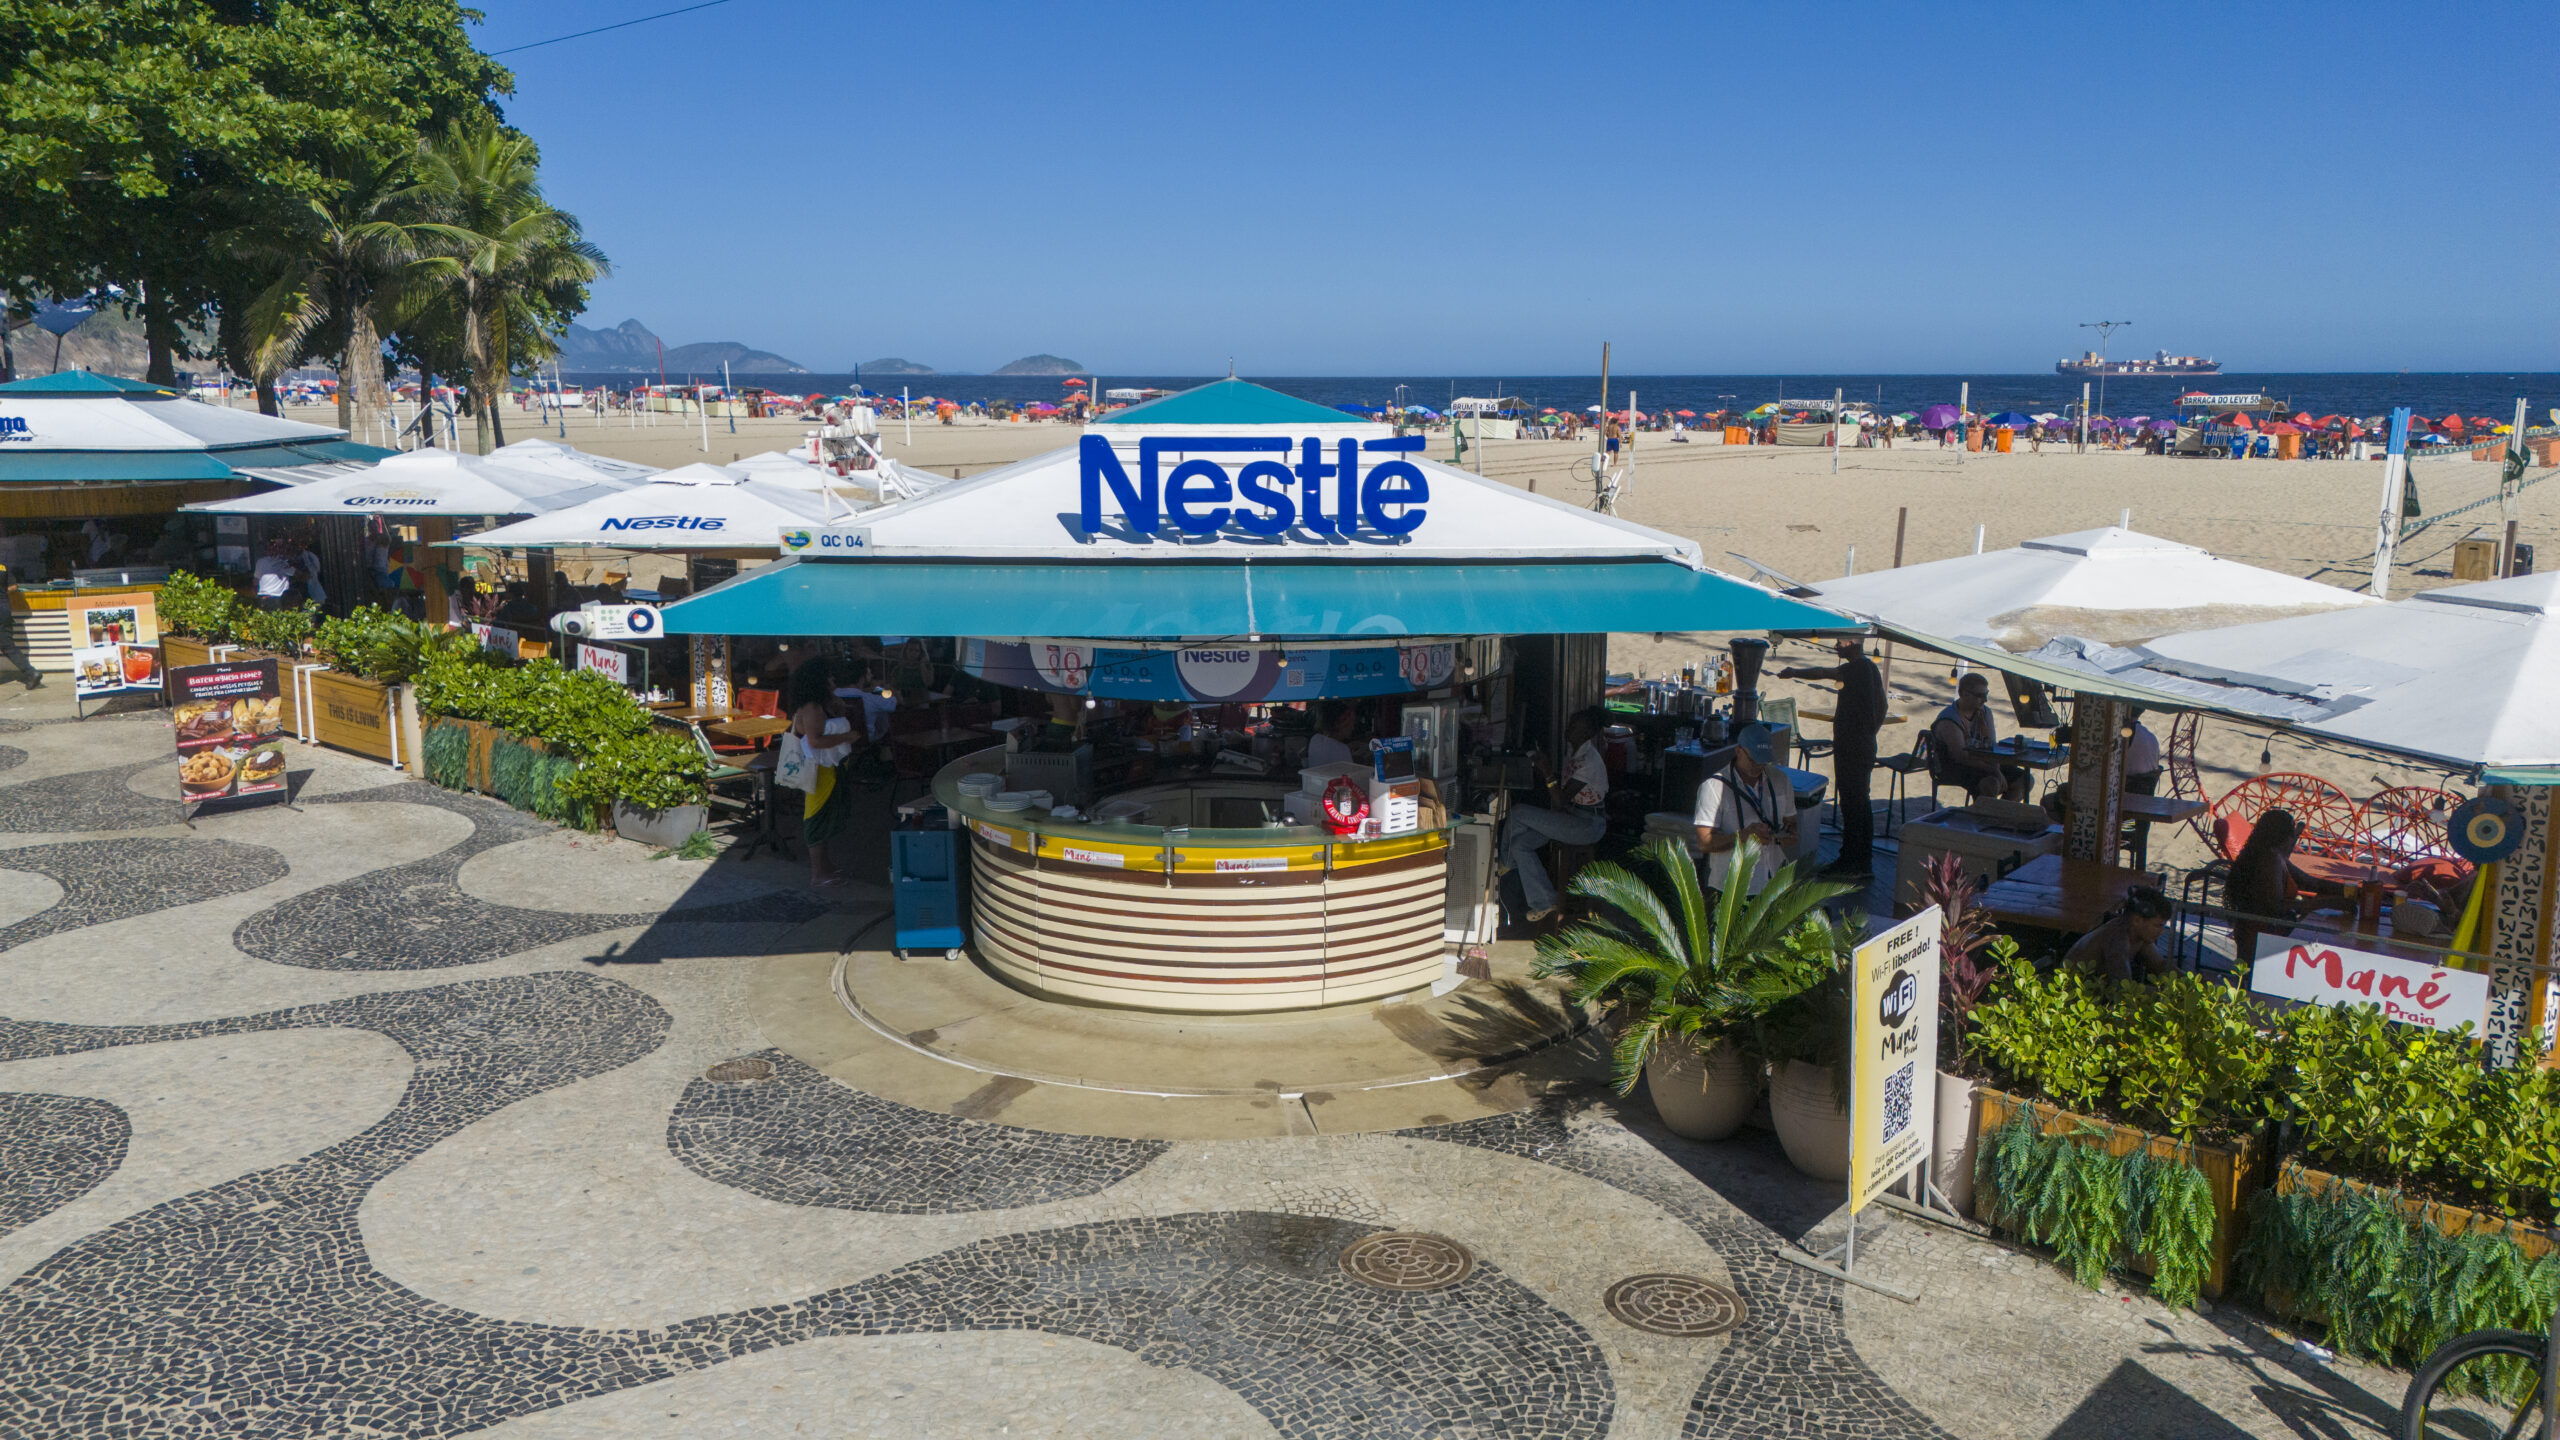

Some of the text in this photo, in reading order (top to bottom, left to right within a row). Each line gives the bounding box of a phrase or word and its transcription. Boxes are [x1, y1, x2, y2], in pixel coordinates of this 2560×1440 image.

[1452, 403, 1483, 411] BRUMR
[2183, 396, 2216, 404] BARRACA
[2218, 396, 2228, 404] DO
[2230, 395, 2248, 404] LEVY
[1079, 434, 1430, 536] Nestlé
[343, 496, 438, 506] Corona
[600, 516, 727, 531] Nestlé
[821, 534, 864, 548] QC 04
[583, 647, 620, 673] Mané
[328, 703, 380, 729] THIS IS LIVING
[1064, 848, 1091, 862] Mané
[1216, 860, 1250, 871] Mané
[1887, 929, 1913, 953] FREE
[1872, 937, 1931, 983] Wi-Fi liberado!
[2285, 944, 2451, 1010] Mané
[2384, 1000, 2436, 1026] Praia
[1881, 1015, 1919, 1061] Mané
